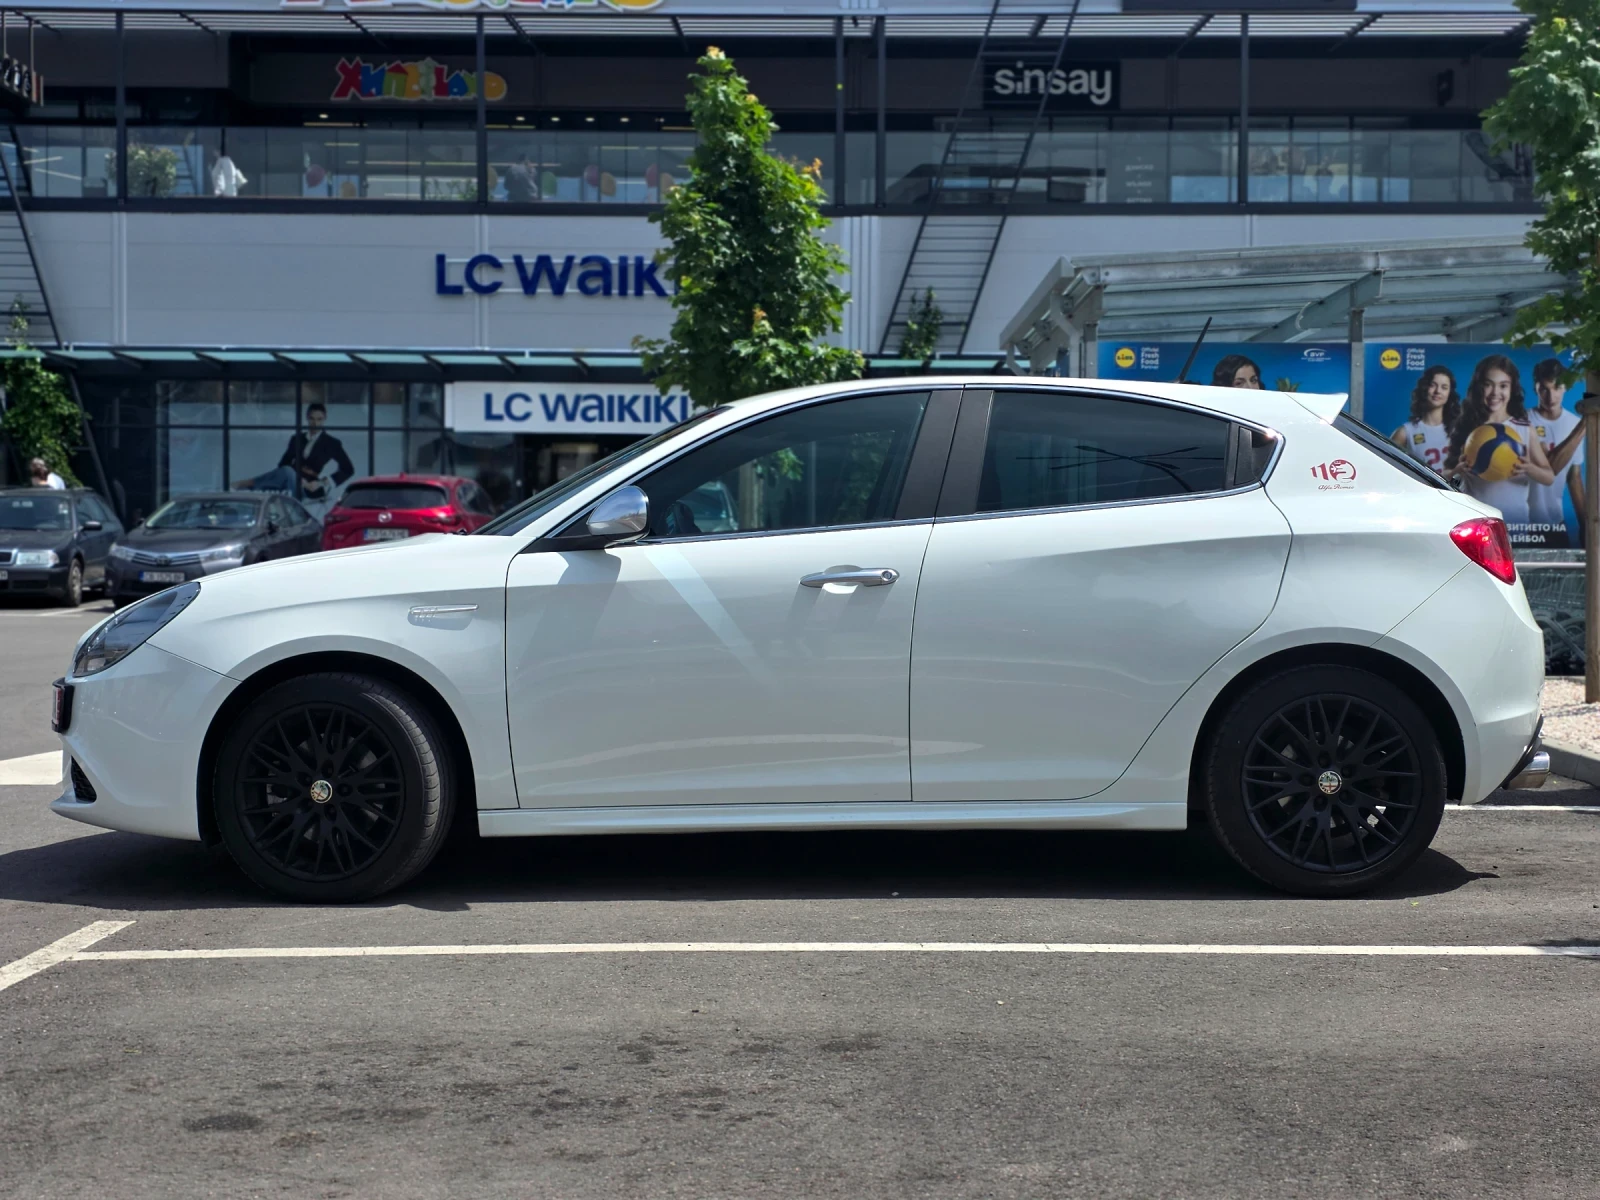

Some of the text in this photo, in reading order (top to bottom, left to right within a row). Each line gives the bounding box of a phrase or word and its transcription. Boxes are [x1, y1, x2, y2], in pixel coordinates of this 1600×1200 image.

[993, 60, 1112, 105] sinsay
[436, 253, 504, 295] LC
[484, 393, 533, 422] LC
[1318, 484, 1333, 492] Alfa
[1552, 523, 1567, 532] НА
